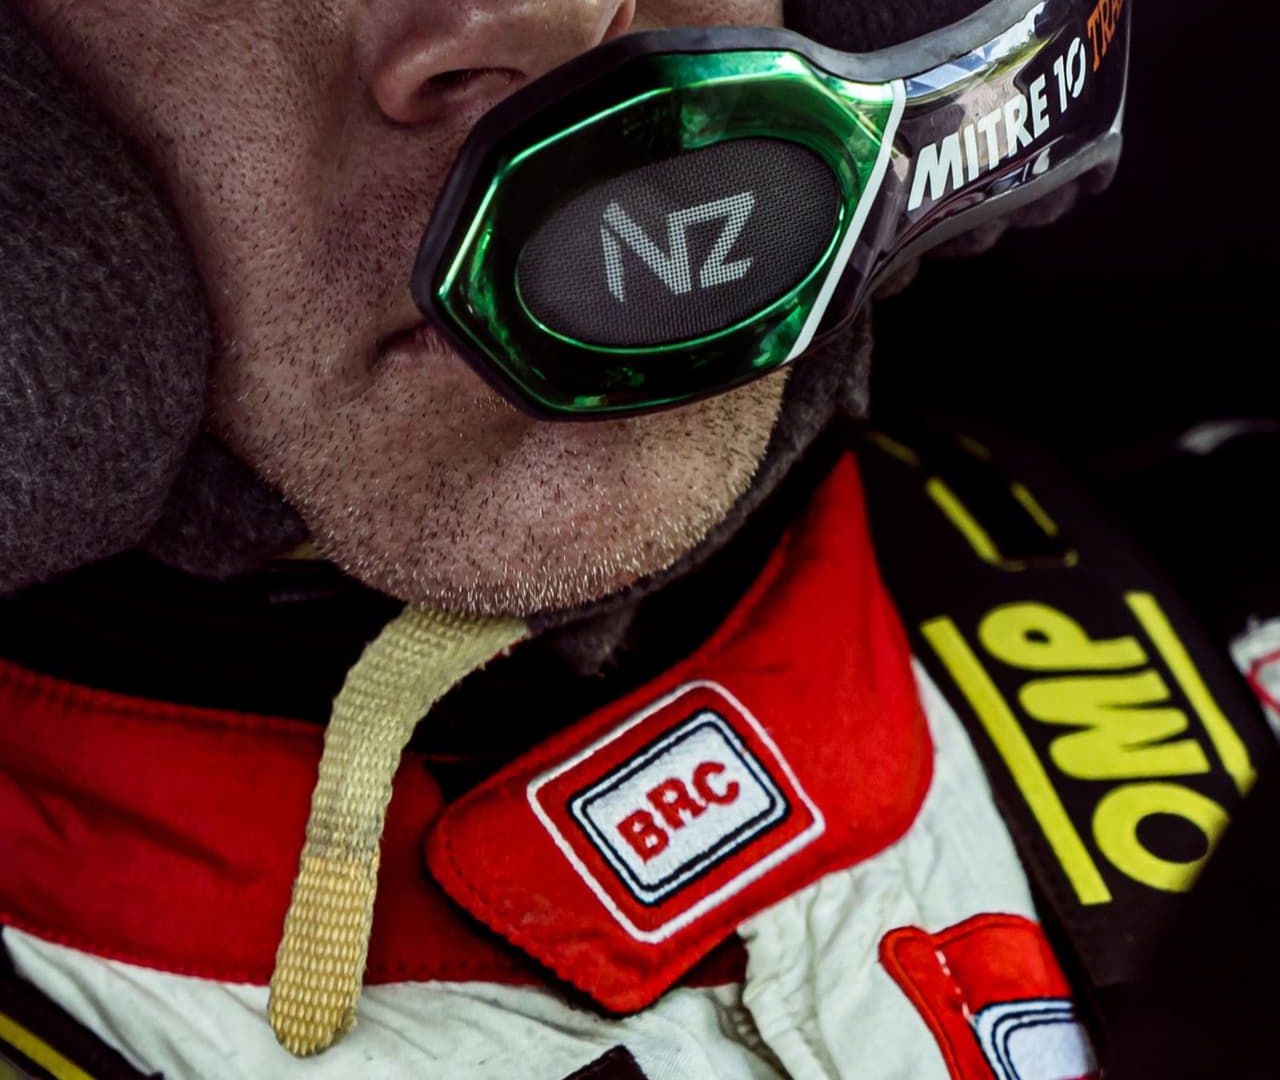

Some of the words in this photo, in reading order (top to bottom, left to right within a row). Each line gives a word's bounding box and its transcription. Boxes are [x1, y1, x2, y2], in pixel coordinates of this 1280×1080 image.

[907, 73, 1050, 211] MITRE
[1053, 36, 1087, 114] 10
[601, 190, 755, 303] NZ
[616, 759, 742, 865] BRC
[978, 602, 1231, 895] OMP
